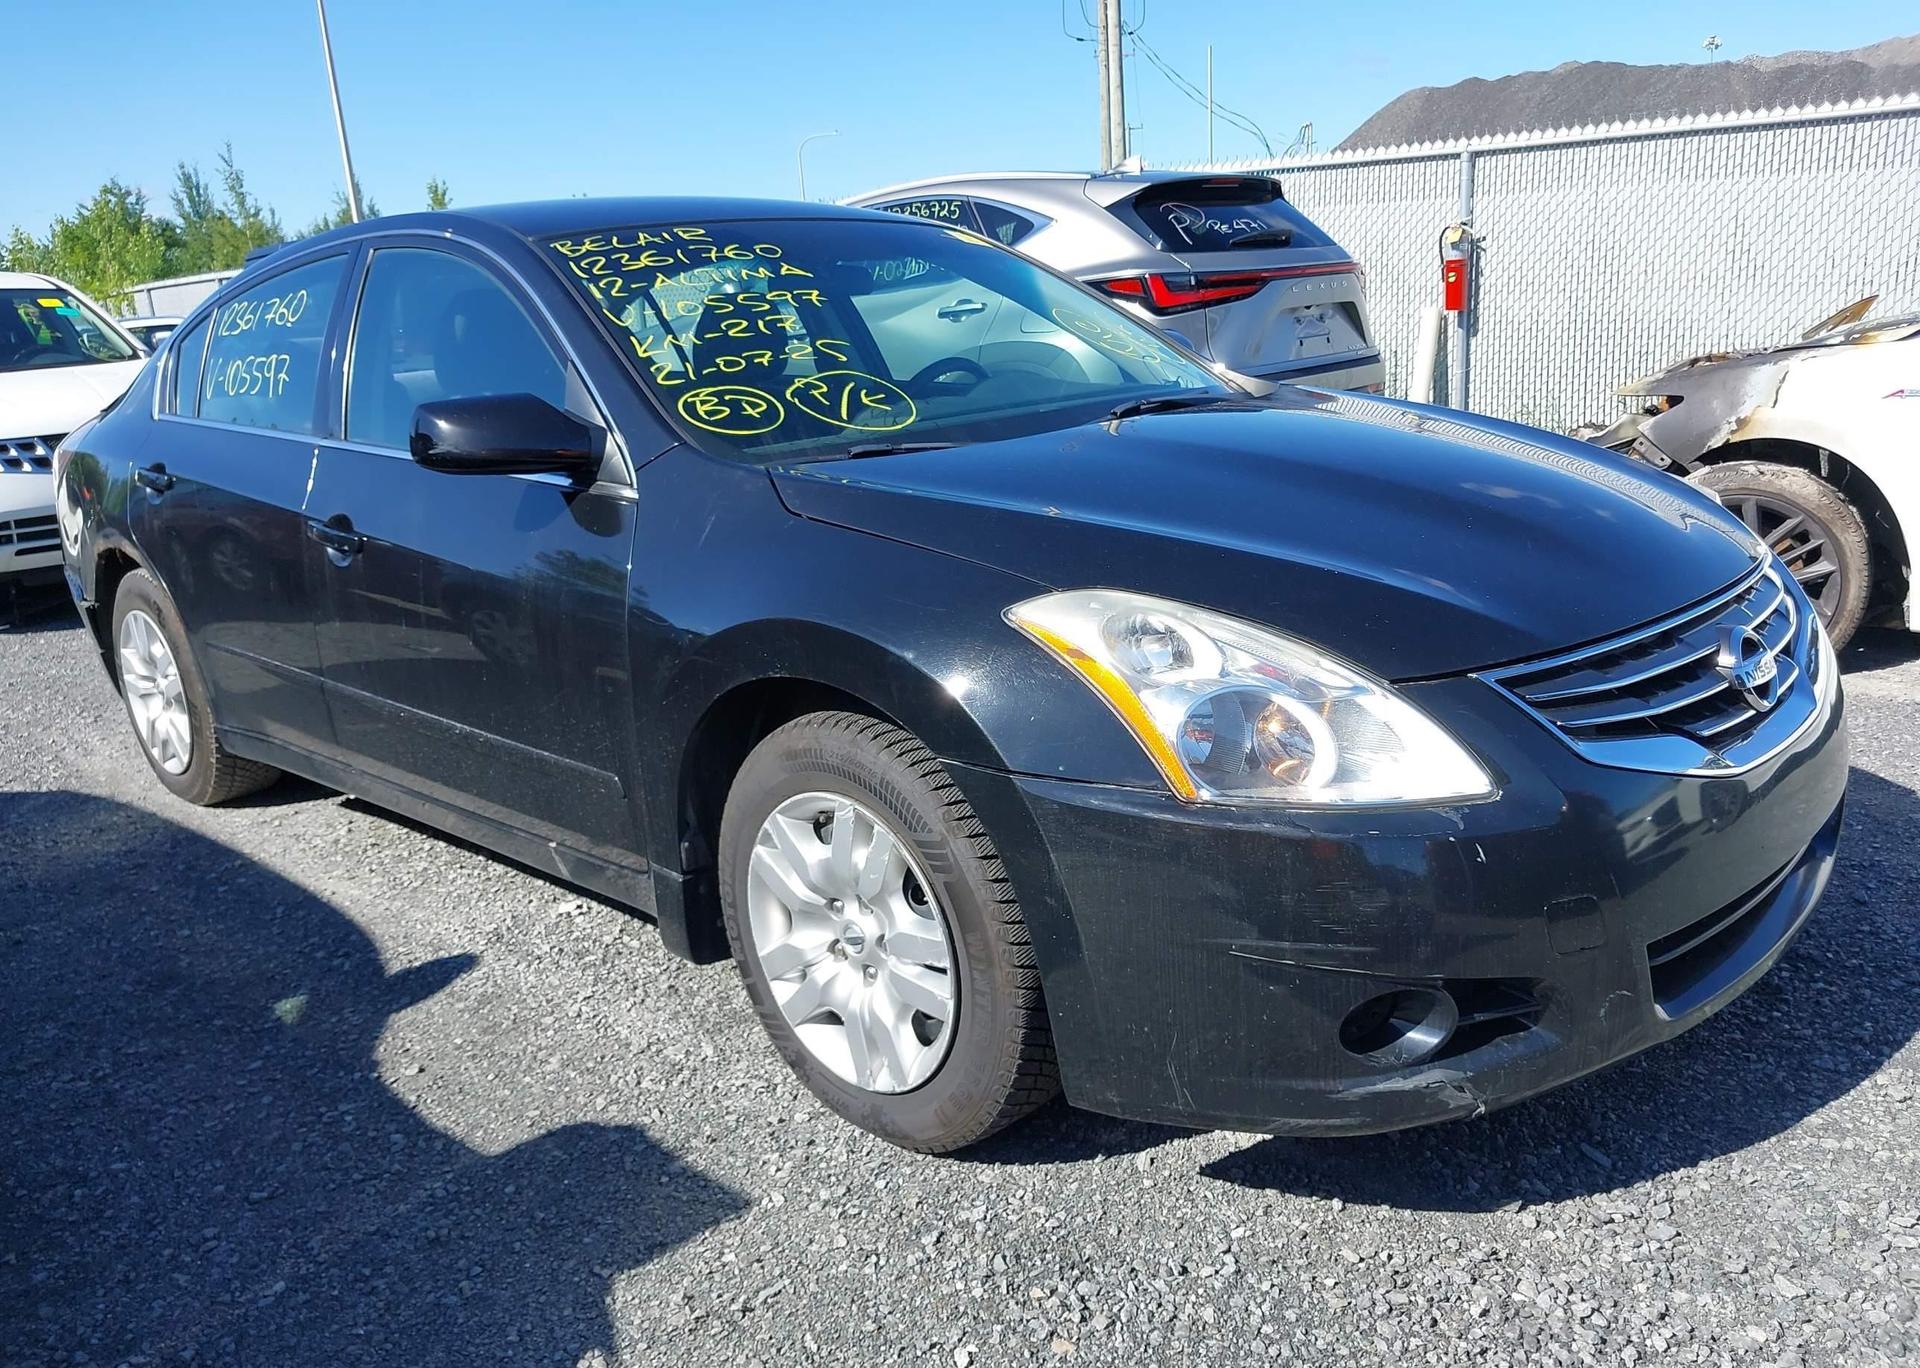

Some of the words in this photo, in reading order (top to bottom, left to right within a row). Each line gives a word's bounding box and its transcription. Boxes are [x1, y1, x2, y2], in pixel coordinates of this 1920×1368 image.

[550, 227, 713, 257] BELAIR
[569, 244, 783, 278] 12361760
[588, 262, 815, 298] 12-ALTIMA
[1292, 281, 1348, 293] LEXUS
[218, 289, 307, 337] 12361760
[629, 315, 799, 357] KM-217
[206, 354, 290, 400] V-105597
[650, 339, 851, 385] 21-07-25
